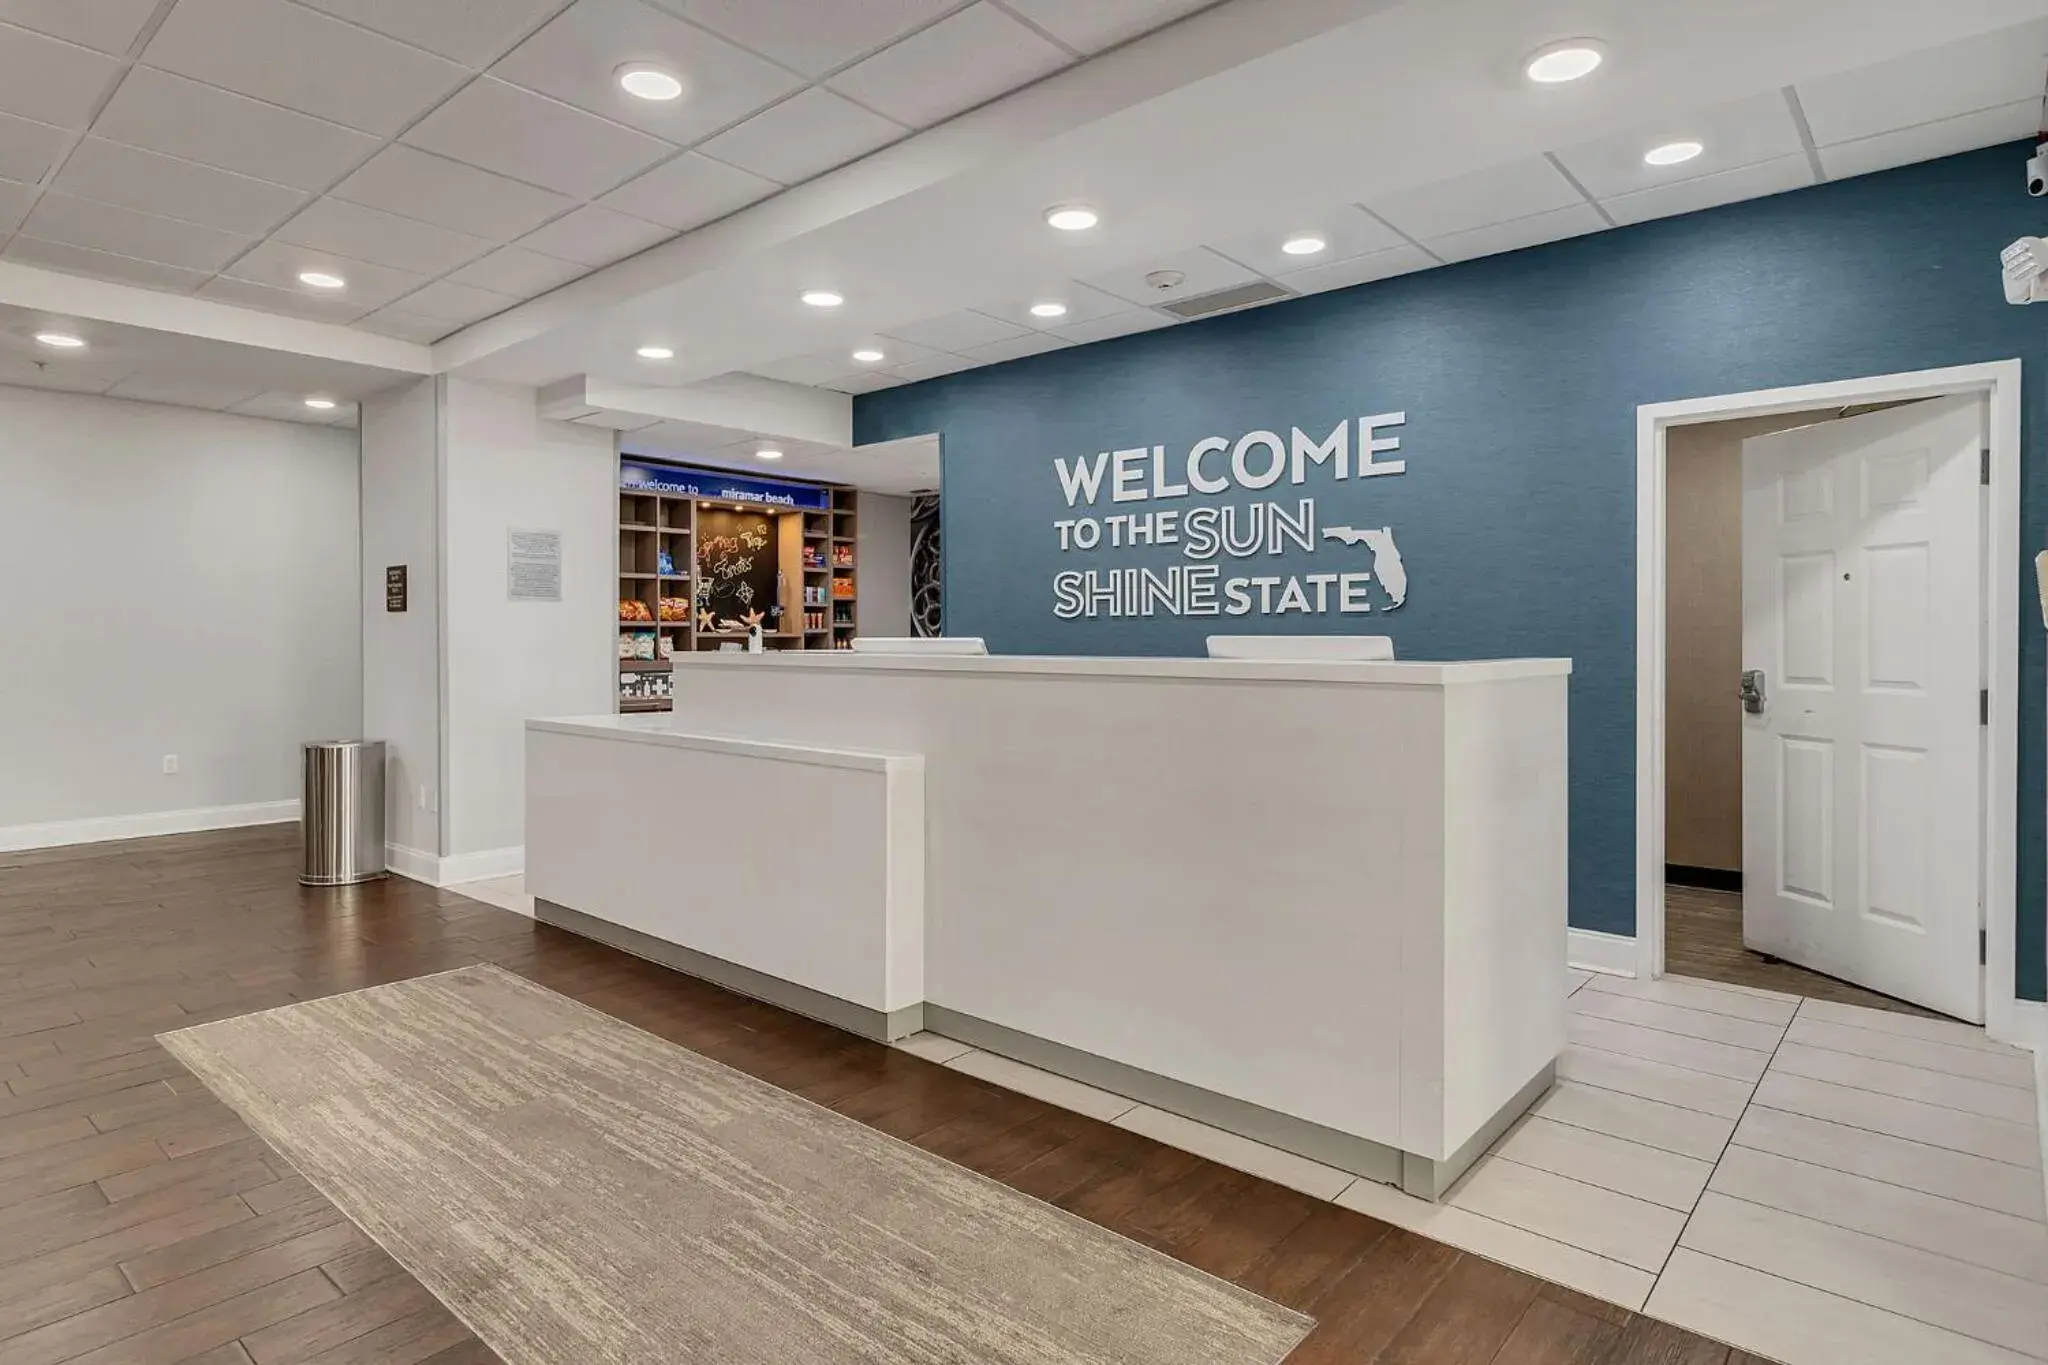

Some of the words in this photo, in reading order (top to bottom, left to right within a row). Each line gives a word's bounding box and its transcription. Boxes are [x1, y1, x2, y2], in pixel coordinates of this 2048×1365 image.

[1054, 411, 1406, 507] WELCOME
[640, 480, 685, 494] welcome
[688, 484, 699, 496] to
[721, 488, 763, 502] miramar
[765, 492, 795, 506] beach
[1054, 518, 1100, 550] TO
[1105, 511, 1179, 547] THE
[1183, 498, 1315, 559] SUN
[1053, 565, 1220, 618] SHINE
[1225, 573, 1371, 615] STATE
